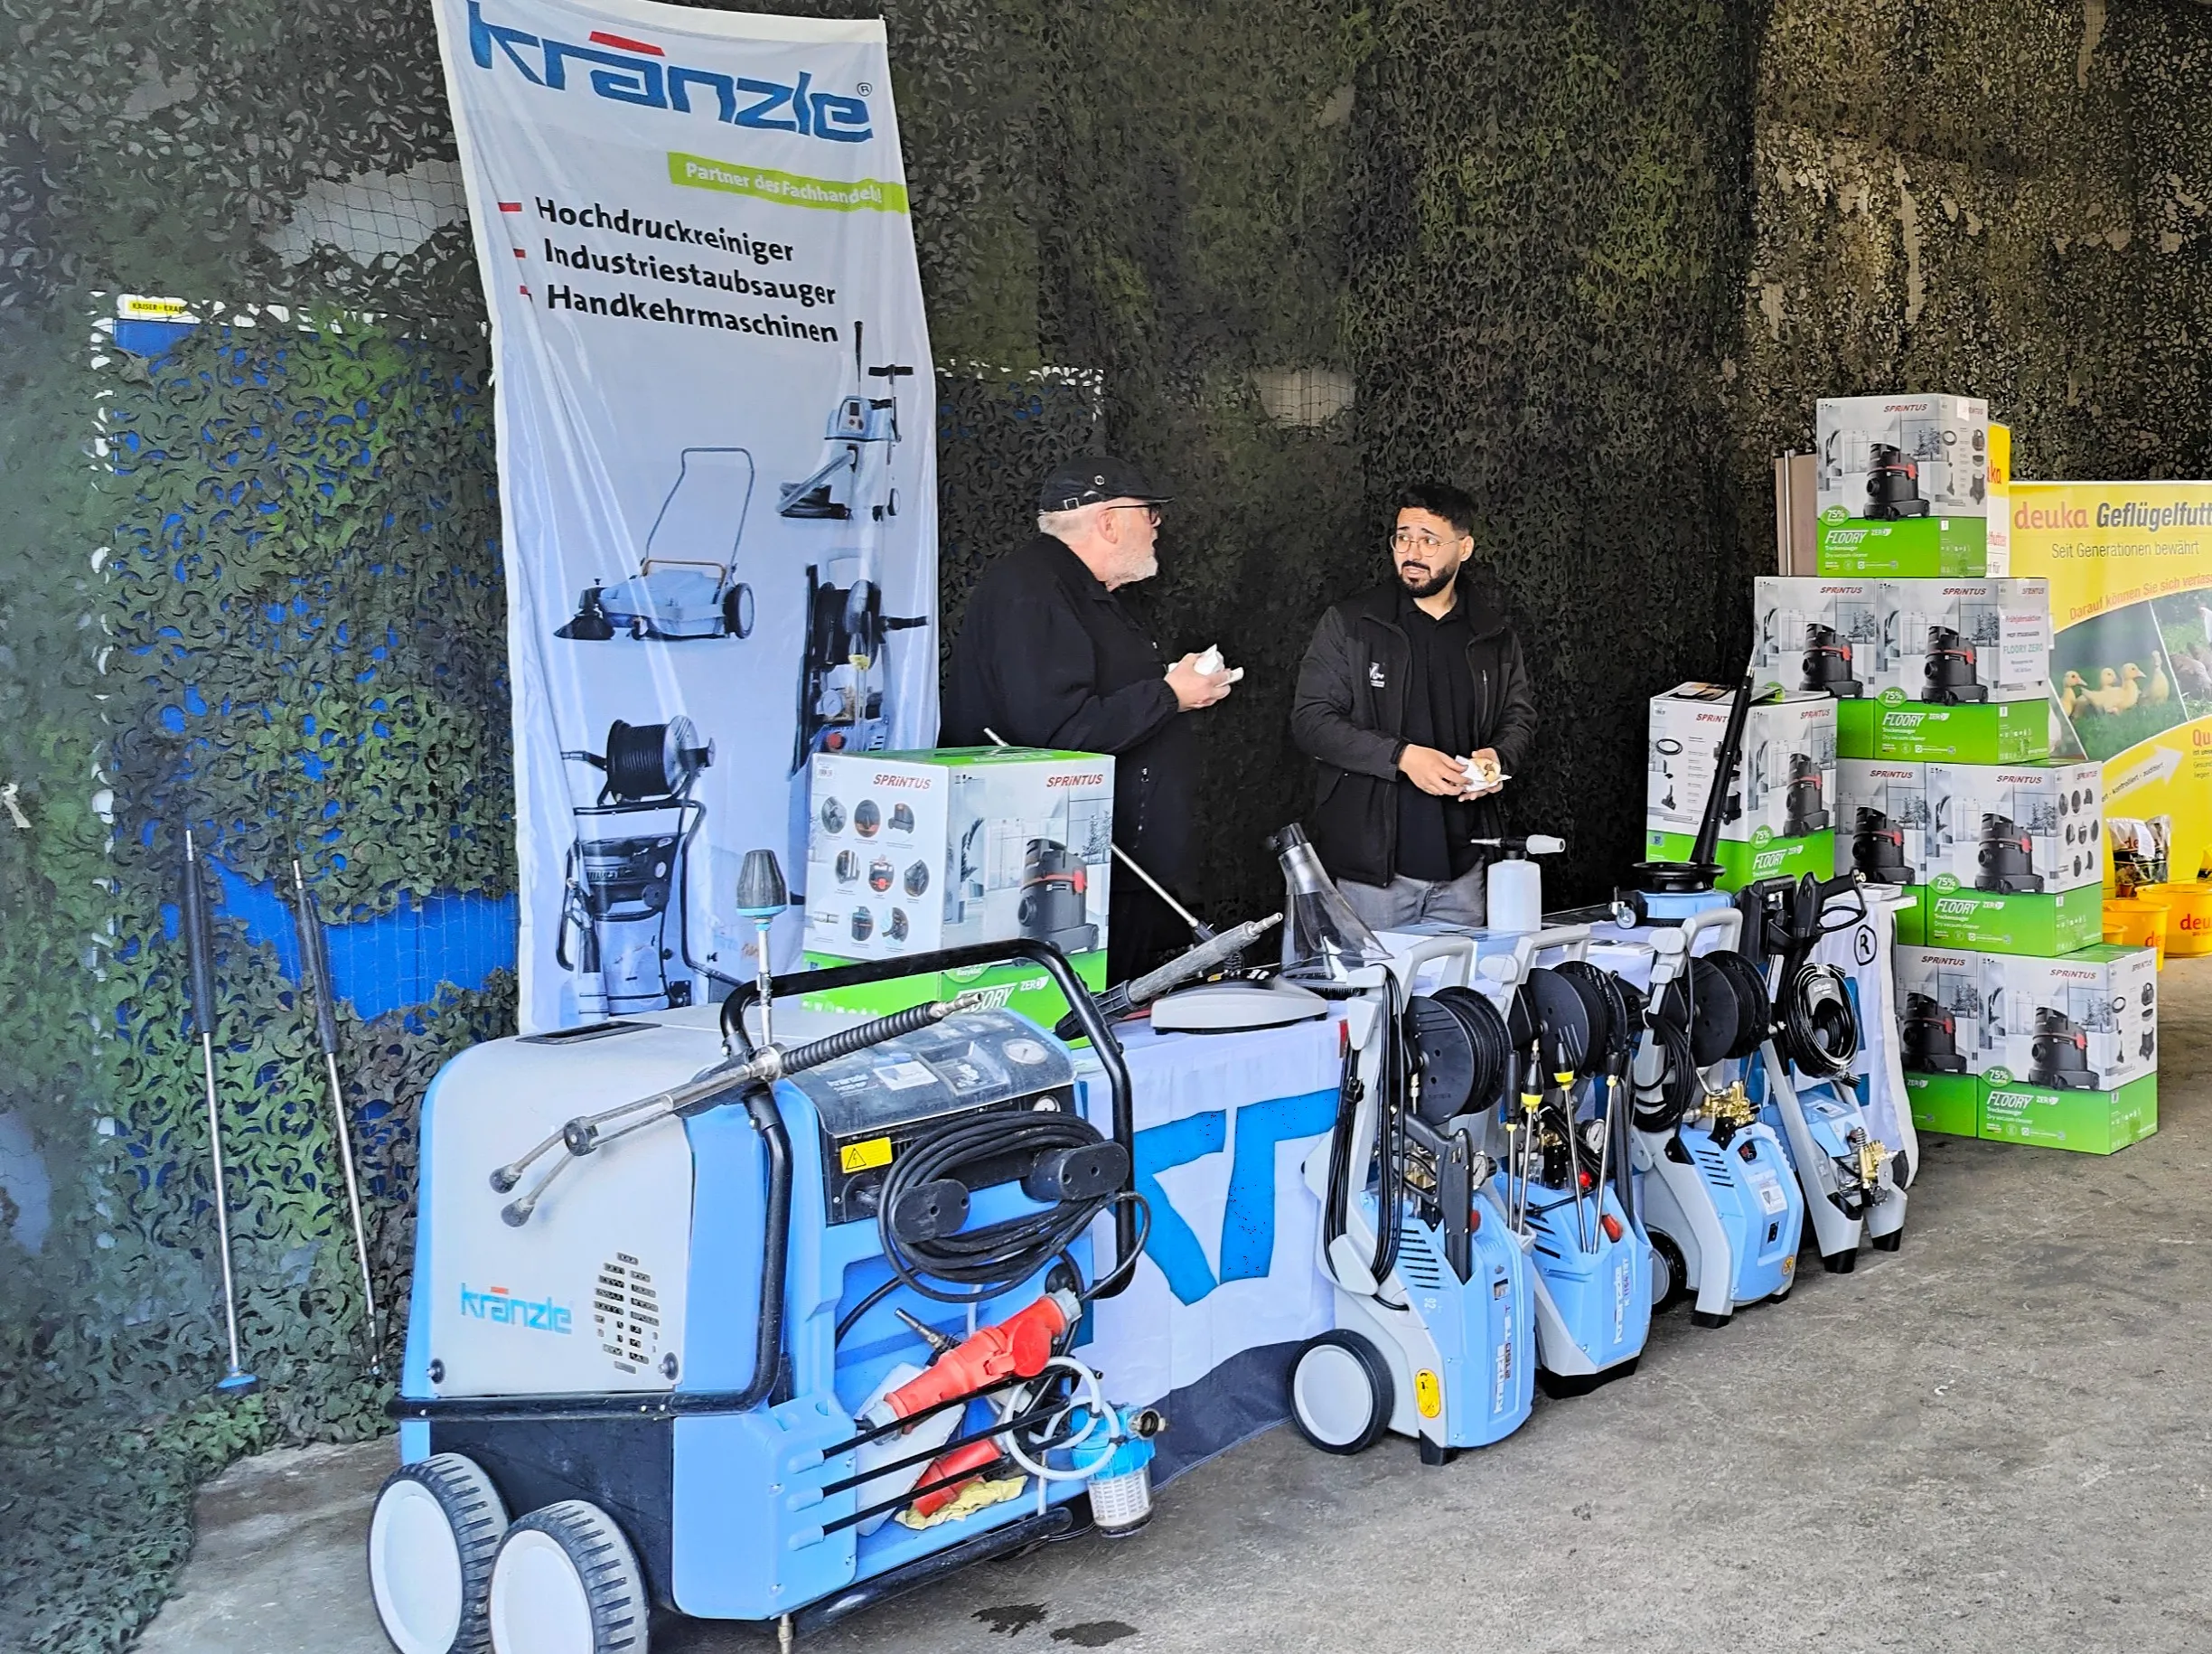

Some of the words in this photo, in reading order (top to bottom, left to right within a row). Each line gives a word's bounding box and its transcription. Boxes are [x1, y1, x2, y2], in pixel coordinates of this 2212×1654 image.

[686, 162, 750, 188] Partner
[755, 174, 779, 193] des
[535, 196, 793, 265] Hochdruckreiniger
[544, 238, 836, 307] Industriestaubsauger
[548, 285, 839, 343] Handkehrmaschinen
[1883, 403, 1928, 413] SPRiNTUS
[1827, 510, 1846, 518] 75%
[2014, 502, 2089, 530] deuka
[2096, 502, 2212, 532] Geflügelfutt
[1825, 530, 1869, 544] FLOORY
[2052, 543, 2074, 558] Seit
[2077, 541, 2151, 558] Generationen
[2155, 540, 2199, 556] bewährt
[1943, 587, 1986, 596] SPRiNTUS
[2070, 597, 2103, 620] Darauf
[2105, 587, 2141, 607] können
[2143, 582, 2158, 597] Sie
[2160, 577, 2180, 591] sich
[2002, 644, 2027, 654] FLOORY
[2028, 644, 2043, 652] ZERO
[1885, 691, 1903, 700] 75%
[1696, 713, 1728, 723] SPRiNT
[1882, 712, 1926, 727] FLOORY
[1046, 774, 1103, 787] SPRiNTUS
[1870, 770, 1913, 778] SPRiNTUS
[1996, 775, 2042, 785] SPRiNTUS
[873, 774, 932, 789] SPRiNTUS
[1753, 850, 1787, 869] FLOORY
[1937, 877, 1956, 886] 75%
[1935, 898, 1981, 915] FLOORY
[1921, 955, 1965, 966] SPRiNTUS
[2050, 969, 2096, 979] SPRiNTUS
[1020, 976, 1049, 991] ZERO
[1990, 1069, 2009, 1079] 75%
[1987, 1091, 2034, 1109] FLOORY
[461, 1283, 572, 1335] kränzle
